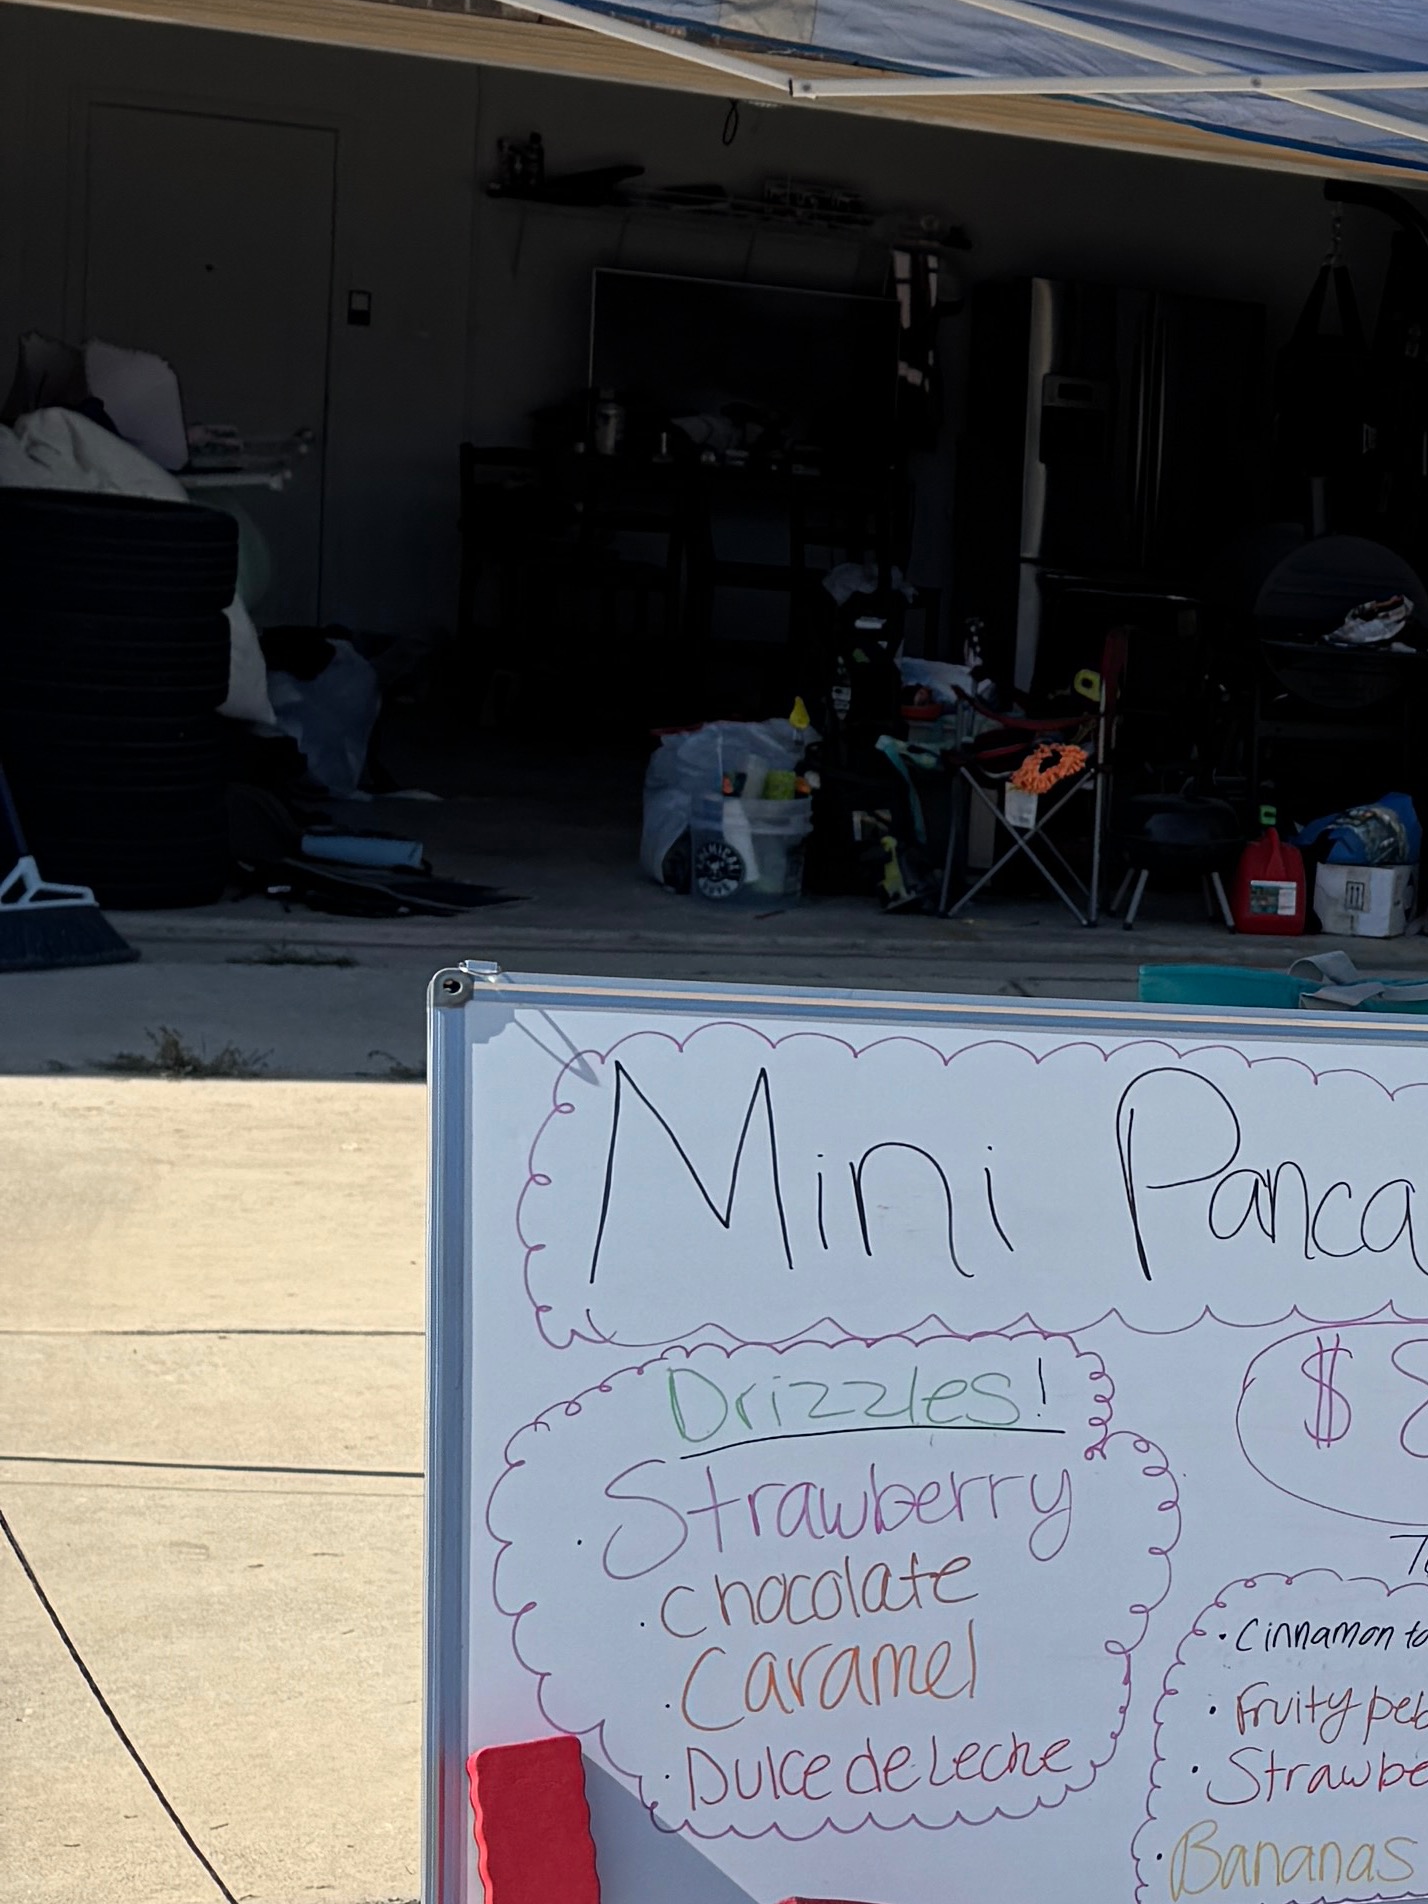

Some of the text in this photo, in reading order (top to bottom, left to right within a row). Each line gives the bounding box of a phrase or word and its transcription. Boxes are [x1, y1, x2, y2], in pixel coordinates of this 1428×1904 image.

[591, 1061, 1013, 1283] Mini
[667, 1356, 1046, 1442] Drizzles!
[602, 1459, 1073, 1579] Strawberry
[687, 1746, 832, 1811] Dulce
[1170, 1819, 1418, 1902] Bananas
